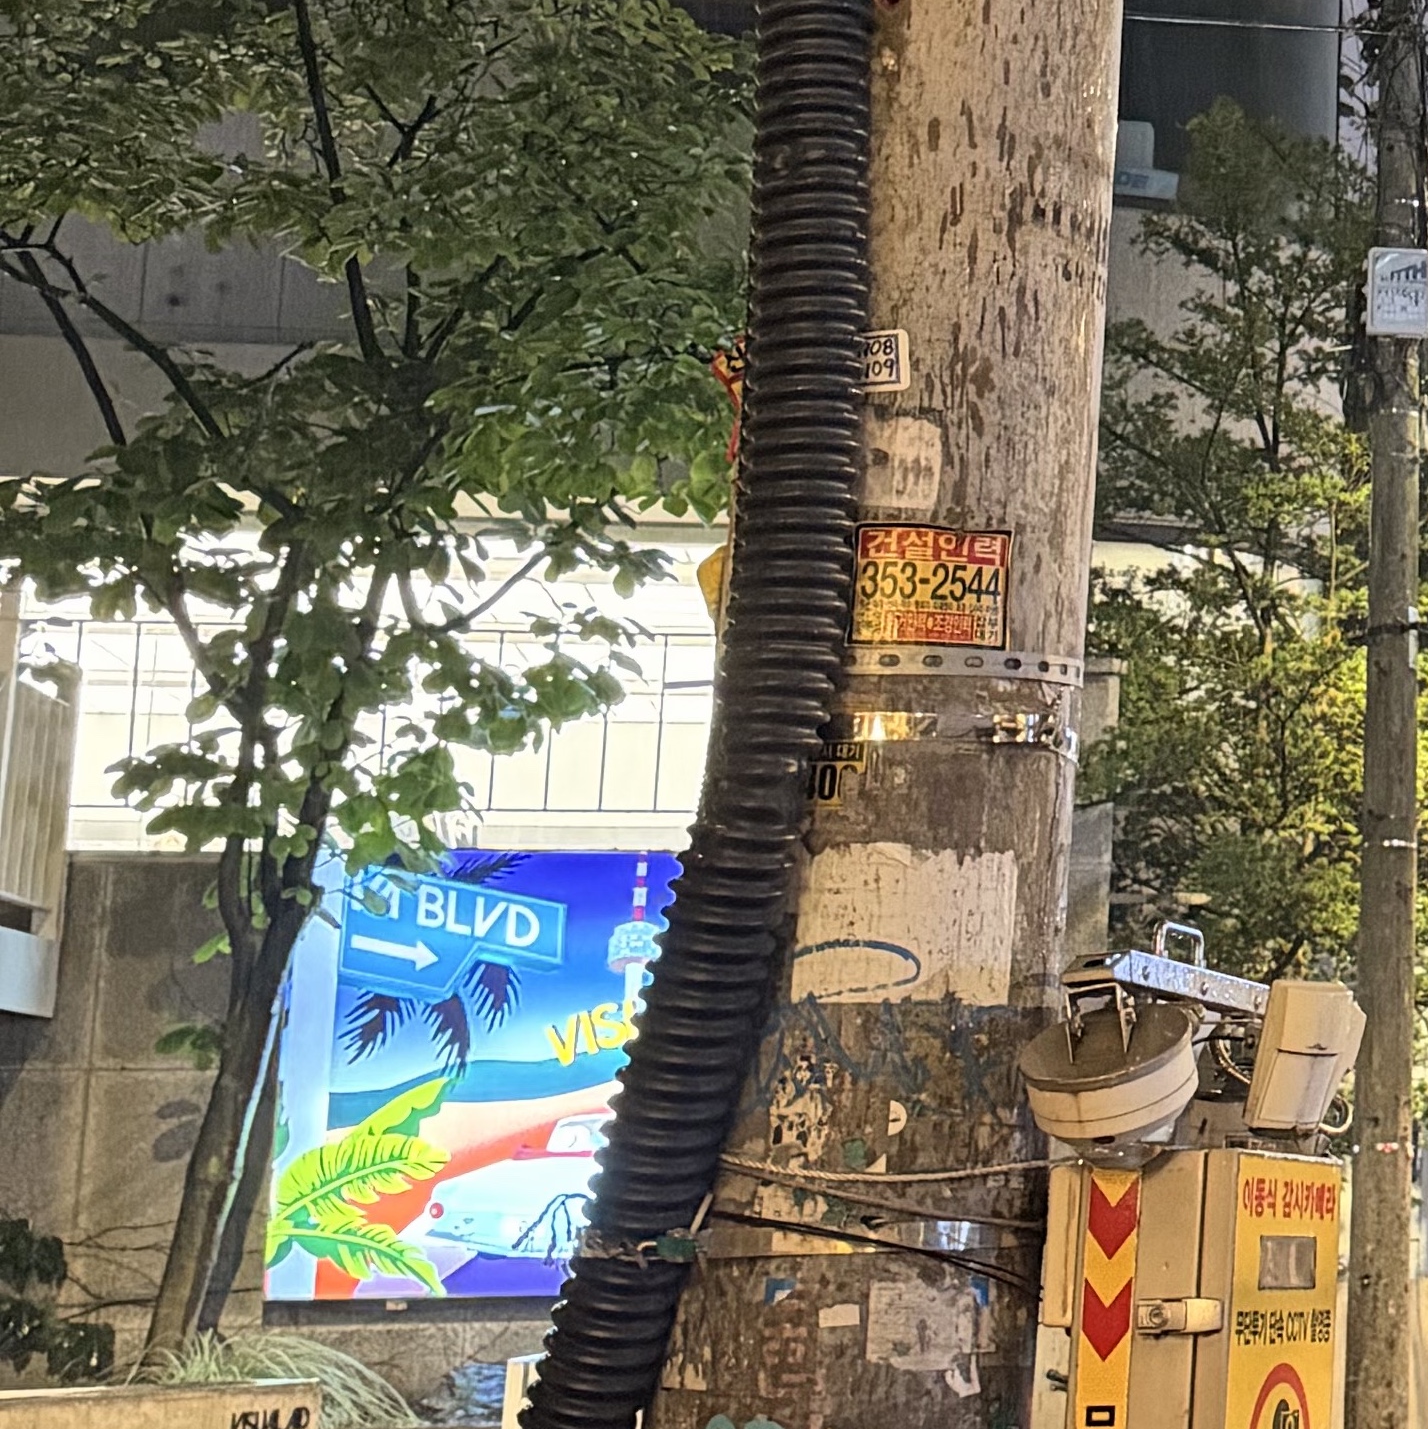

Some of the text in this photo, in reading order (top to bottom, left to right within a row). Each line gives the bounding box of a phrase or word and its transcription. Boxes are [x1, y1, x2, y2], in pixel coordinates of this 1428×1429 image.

[867, 530, 1001, 565] 건설인력
[860, 560, 1001, 604] 353-2544
[416, 883, 540, 948] BLVD
[1243, 1176, 1336, 1221] 이동식 감시카메라
